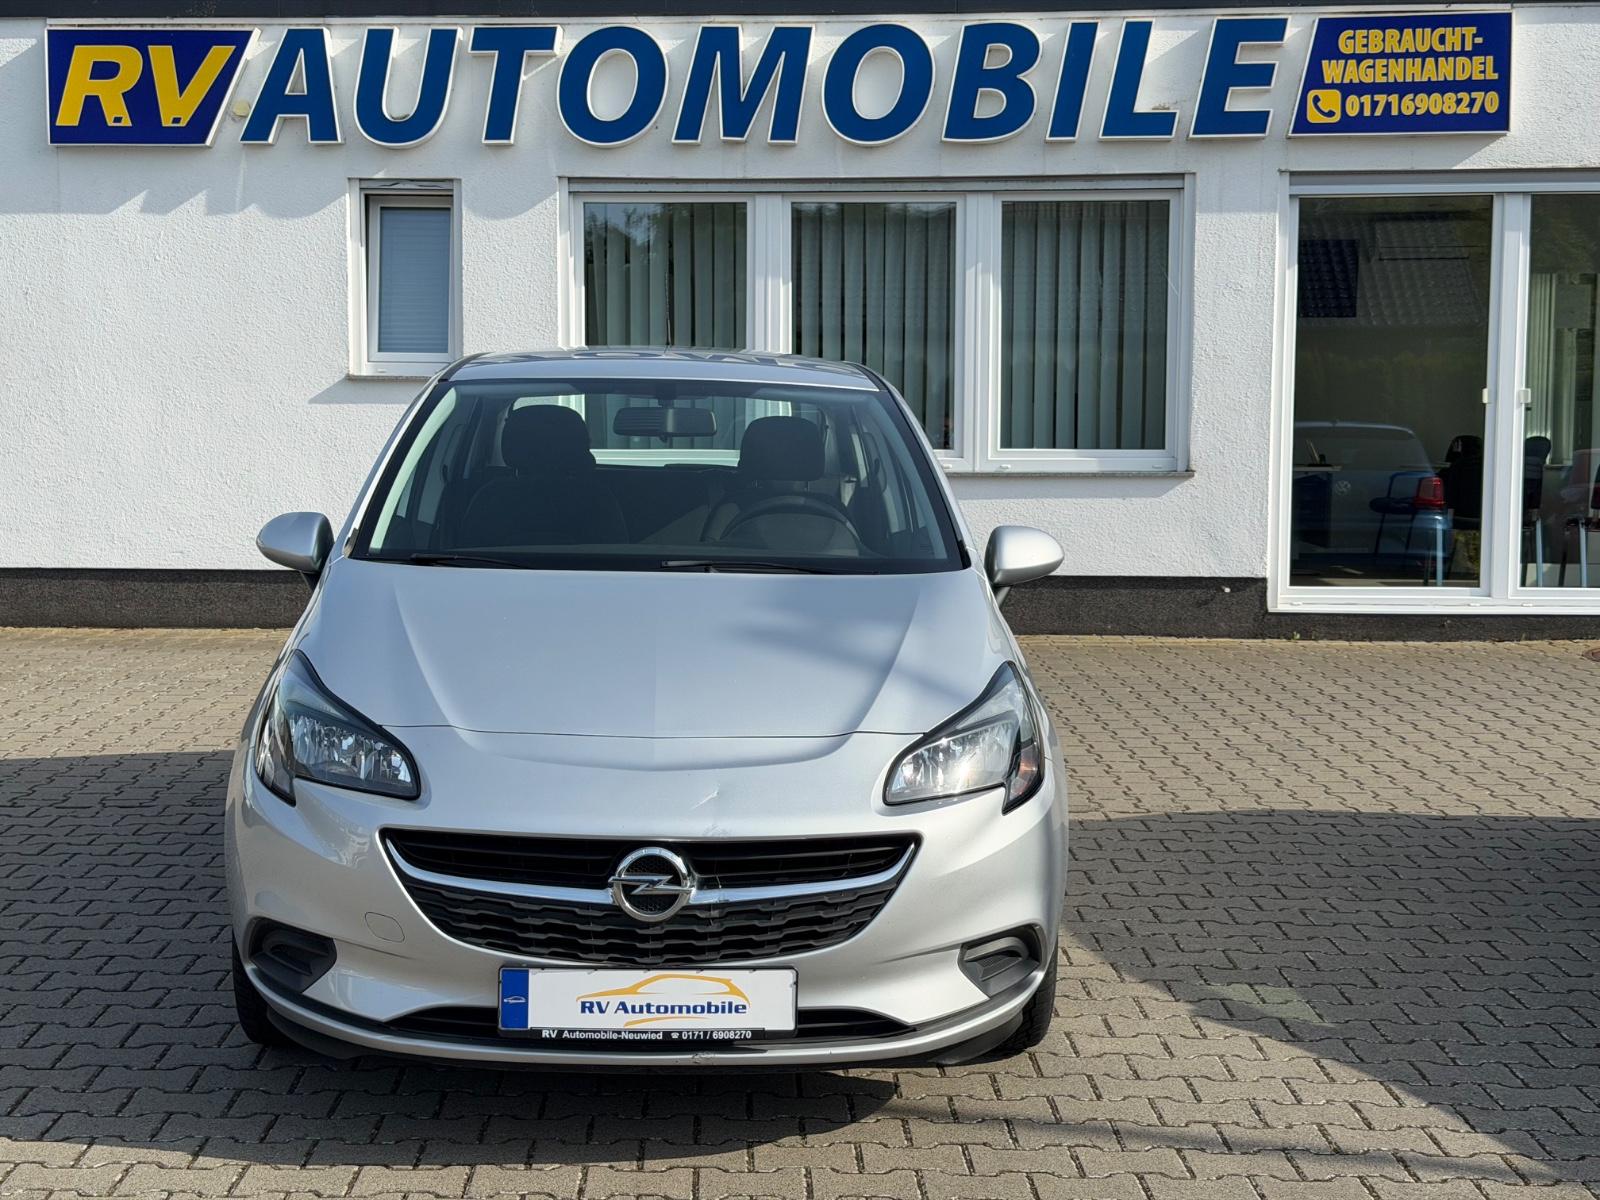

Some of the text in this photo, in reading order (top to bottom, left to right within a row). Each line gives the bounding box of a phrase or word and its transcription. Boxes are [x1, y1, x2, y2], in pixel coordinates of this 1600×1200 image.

[1338, 27, 1483, 54] GEBRAUCHT-
[55, 17, 1290, 148] RV AUTOMOBILE
[1321, 55, 1498, 84] WAGENHANDEL
[1345, 91, 1499, 116] 01716908270
[580, 1001, 747, 1014] RV Automobile
[541, 1029, 557, 1039] RV
[562, 1030, 663, 1040] Automobile-Neuwied
[682, 1030, 703, 1040] 0171
[713, 1030, 752, 1039] 6908270
